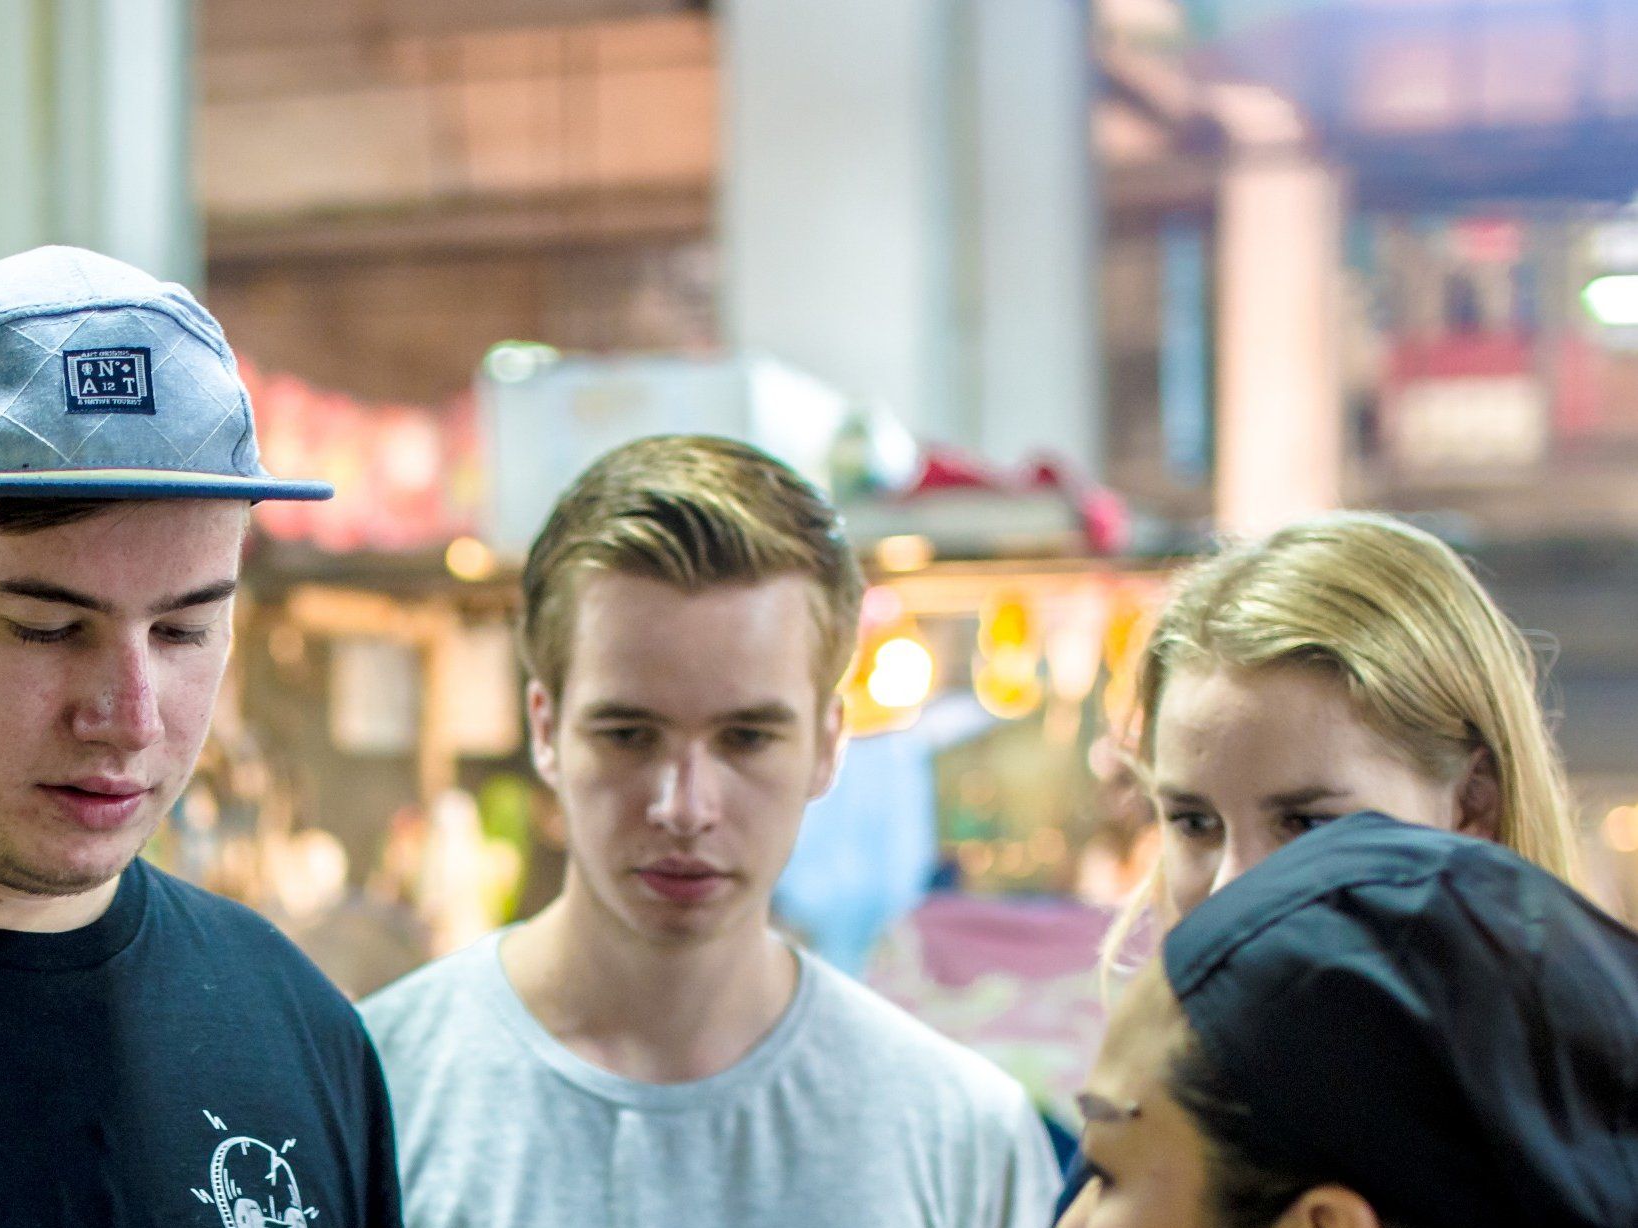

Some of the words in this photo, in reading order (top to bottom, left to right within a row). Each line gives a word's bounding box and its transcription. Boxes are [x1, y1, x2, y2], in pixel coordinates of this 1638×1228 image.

[82, 378, 98, 394] A
[102, 382, 116, 391] 12
[122, 377, 135, 394] T
